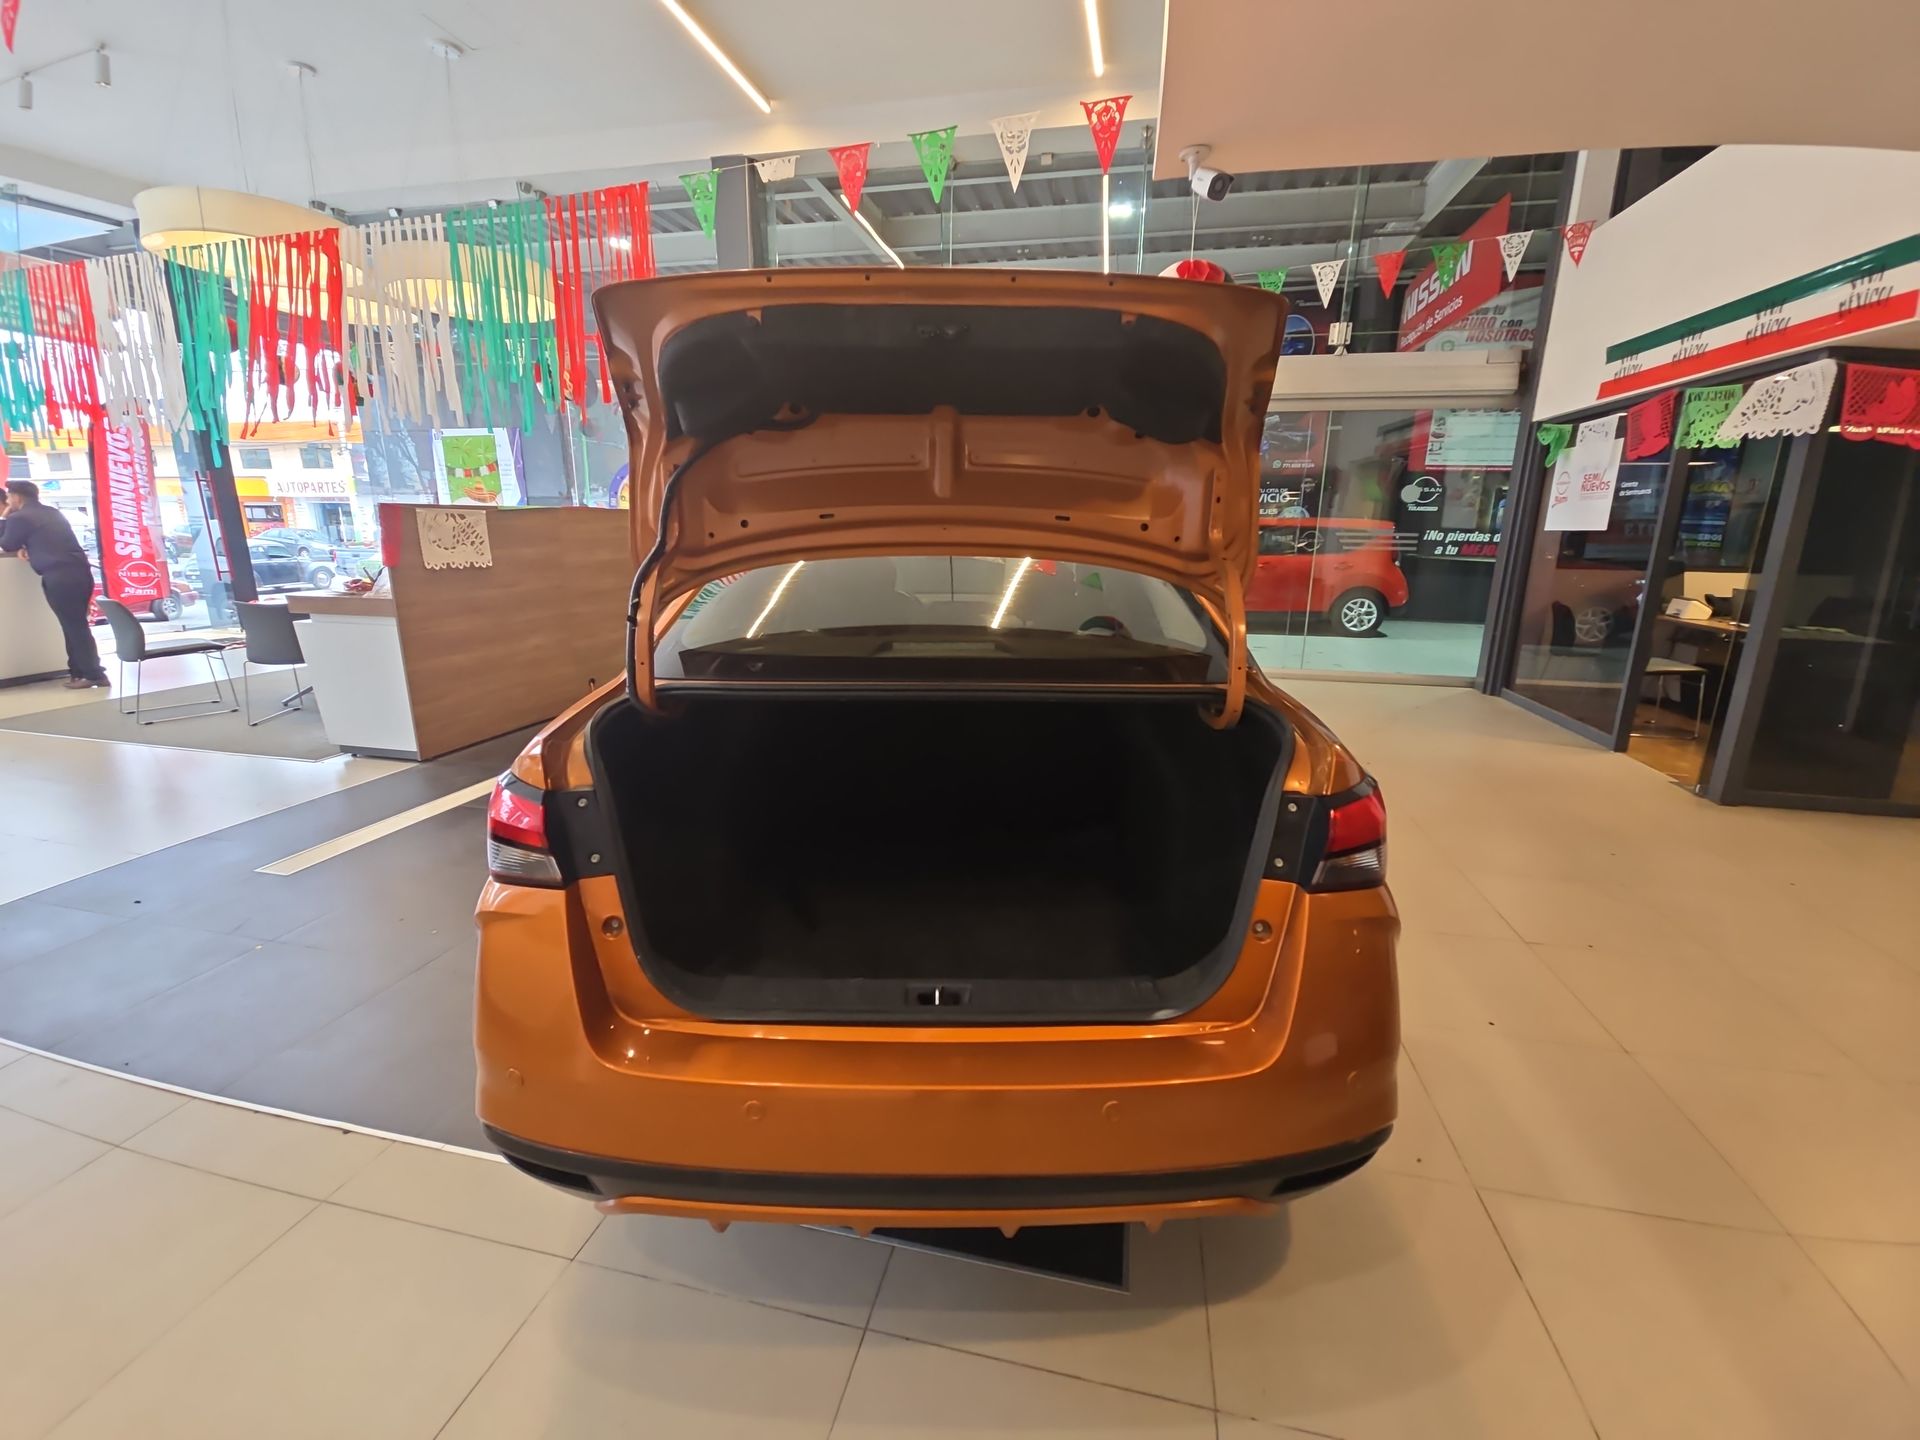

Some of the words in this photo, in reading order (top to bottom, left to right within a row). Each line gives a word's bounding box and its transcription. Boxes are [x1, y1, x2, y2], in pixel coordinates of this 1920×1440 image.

[1403, 240, 1473, 324] NISSN
[1433, 295, 1463, 324] Servicios
[1500, 318, 1523, 328] con
[1465, 328, 1536, 343] NOSOTROS
[277, 480, 346, 494] AUTOPARTES
[1581, 481, 1611, 492] NUEVOS
[1423, 530, 1444, 541] ¡No
[1445, 530, 1491, 543] pierdas
[1434, 546, 1444, 555] a
[1445, 544, 1459, 555] tu
[118, 569, 161, 578] NISSAN
